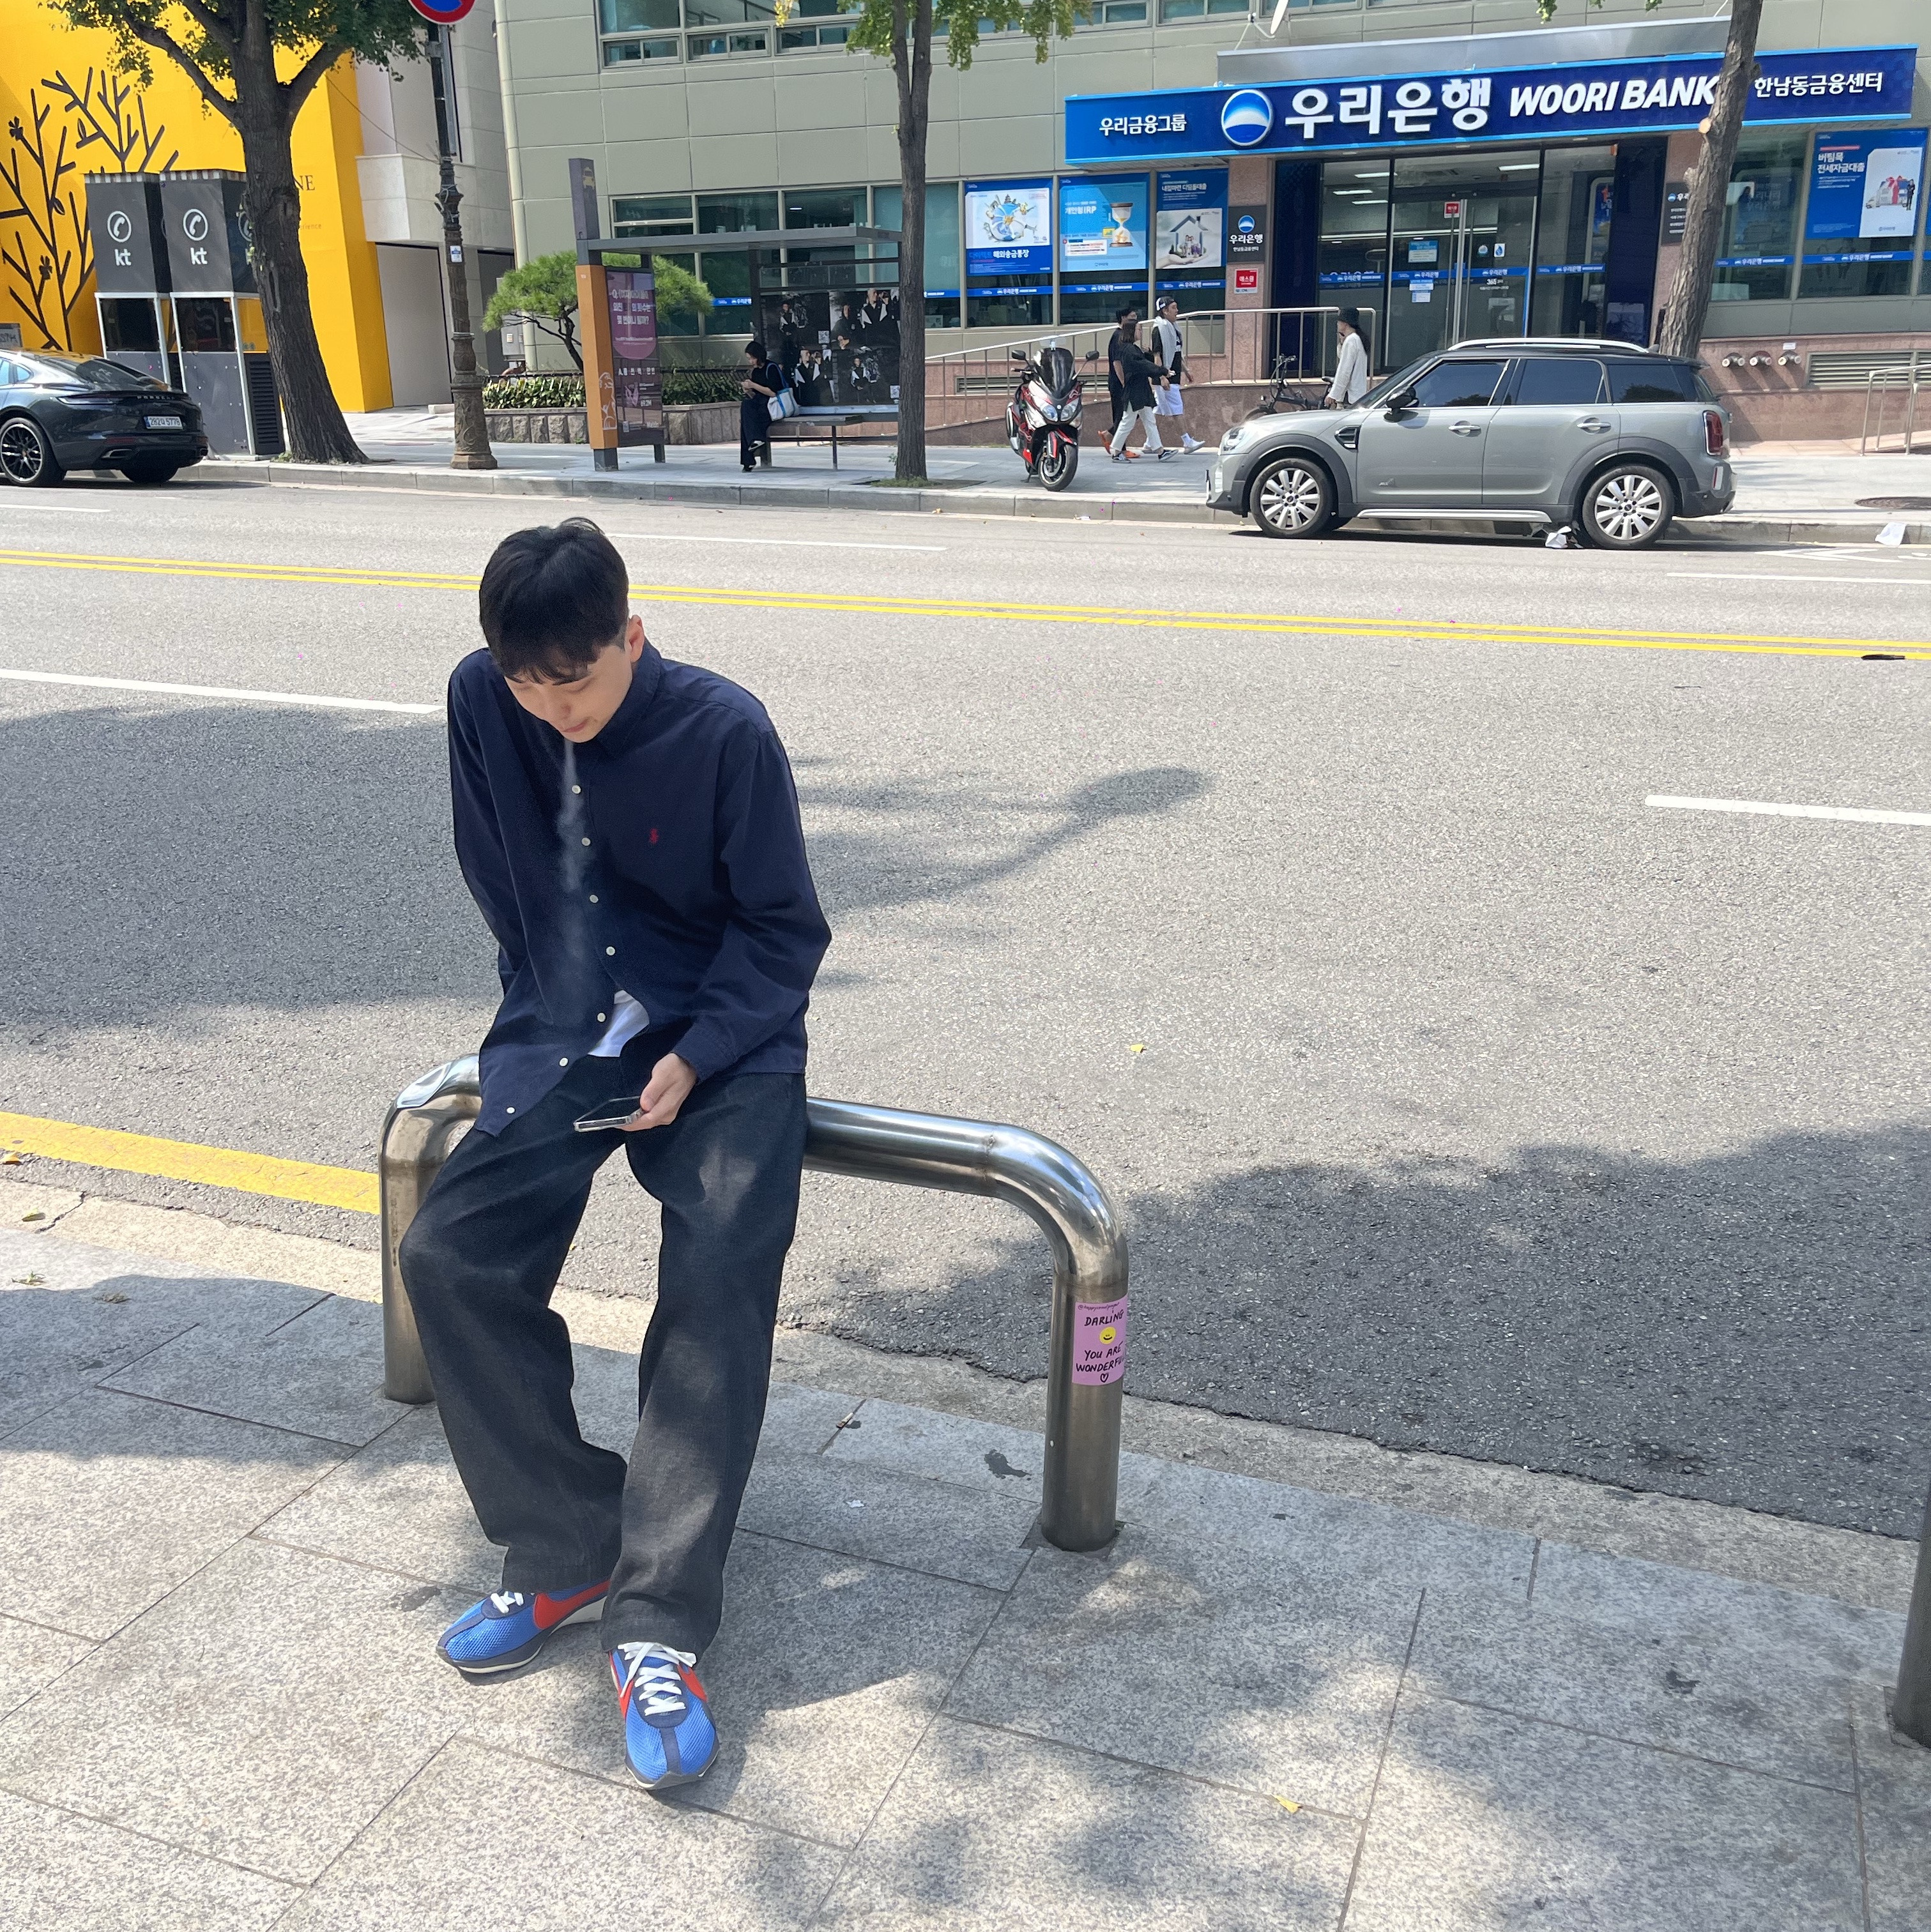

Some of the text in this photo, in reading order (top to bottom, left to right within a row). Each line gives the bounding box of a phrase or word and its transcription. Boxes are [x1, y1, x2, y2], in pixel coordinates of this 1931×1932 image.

[1754, 72, 1883, 98] 한남동금융센터
[1509, 75, 1720, 117] WOORI BANK
[1285, 77, 1492, 139] 우리은행
[1099, 114, 1187, 136] 우리금융그룹
[1229, 234, 1263, 245] 우리은행
[114, 248, 132, 266] kt
[190, 247, 208, 265] kt
[1085, 1341, 1123, 1361] YOU ARE
